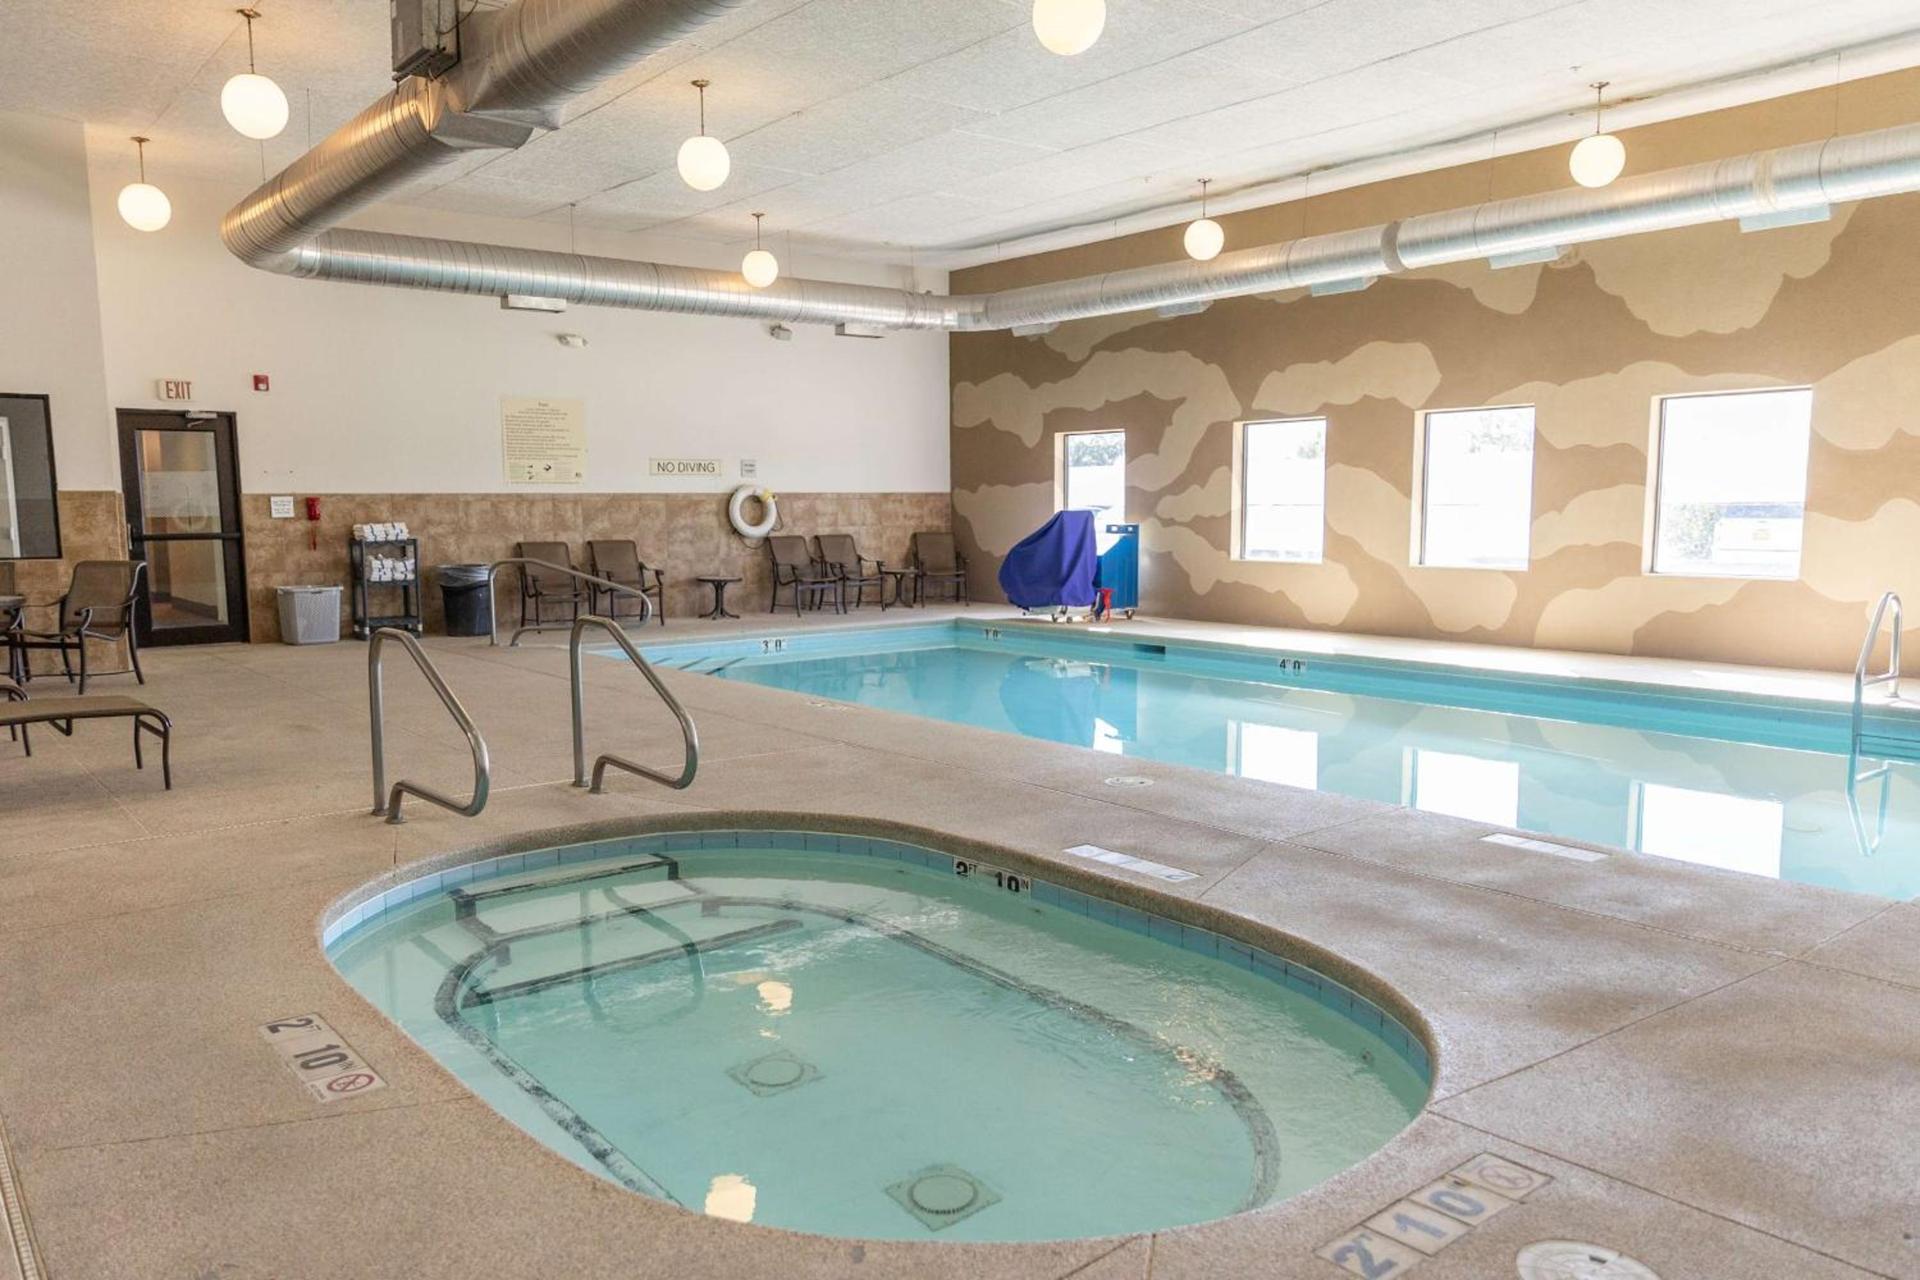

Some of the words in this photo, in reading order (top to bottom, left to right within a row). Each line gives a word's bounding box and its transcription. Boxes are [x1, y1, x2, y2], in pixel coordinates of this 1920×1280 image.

[165, 380, 192, 400] EXIT
[657, 461, 675, 473] NO
[677, 461, 716, 473] DIVING
